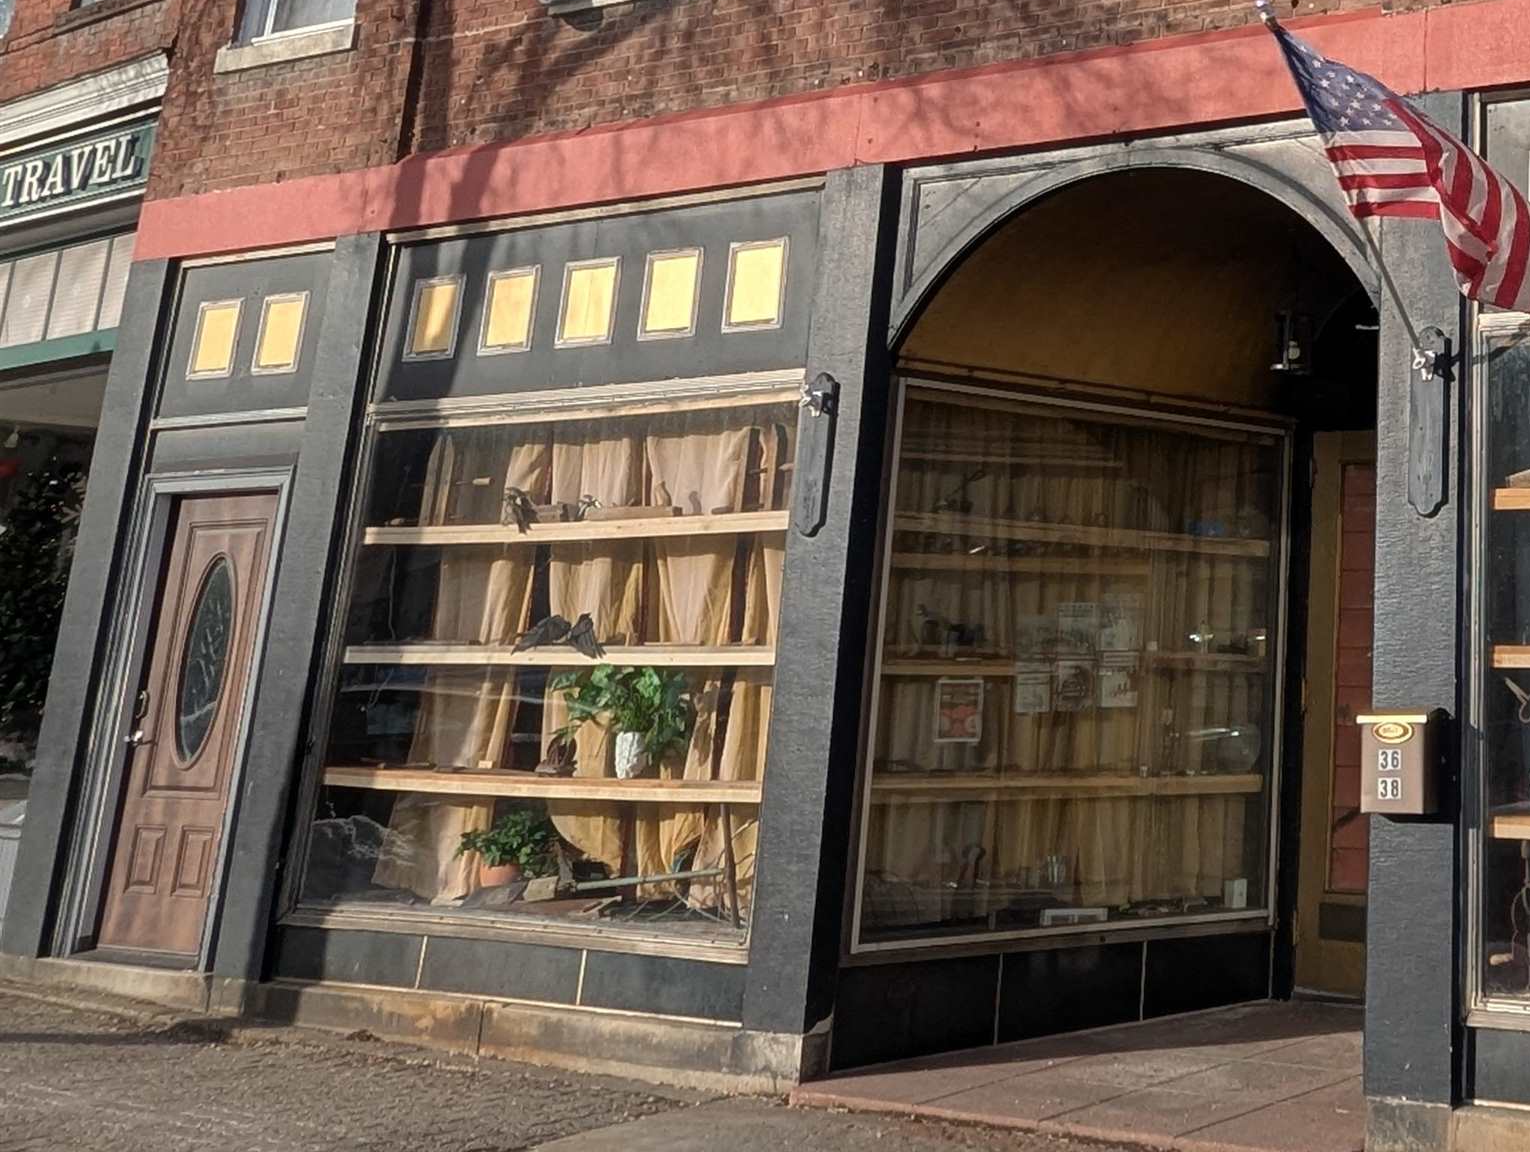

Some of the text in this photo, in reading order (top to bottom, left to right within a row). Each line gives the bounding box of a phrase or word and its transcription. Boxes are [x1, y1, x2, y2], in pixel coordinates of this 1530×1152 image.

[1, 135, 138, 207] TRAVEL
[1380, 750, 1400, 769] 36
[1380, 779, 1400, 798] 38
